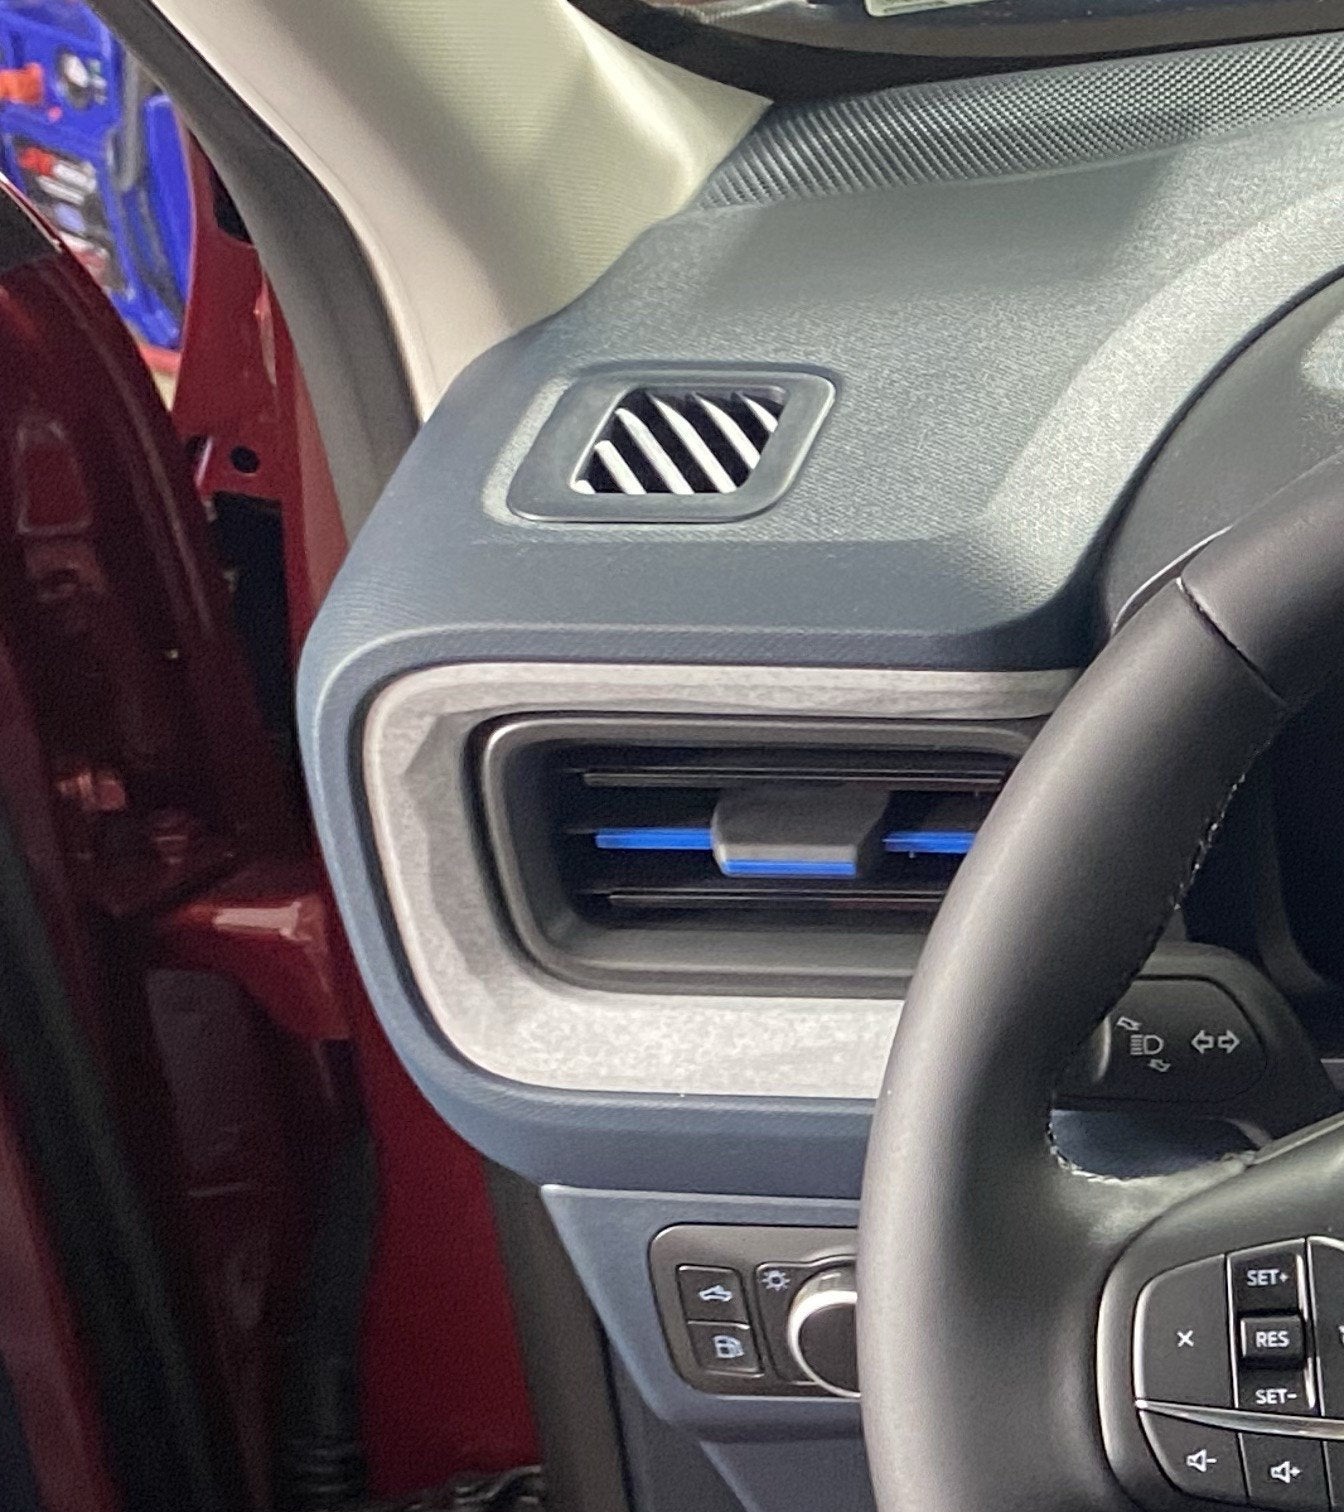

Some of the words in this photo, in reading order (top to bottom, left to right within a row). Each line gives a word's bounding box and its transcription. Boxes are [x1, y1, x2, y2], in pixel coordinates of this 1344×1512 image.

[1247, 1268, 1289, 1286] SET+
[1255, 1330, 1290, 1348] RES
[1255, 1388, 1298, 1405] SET-
